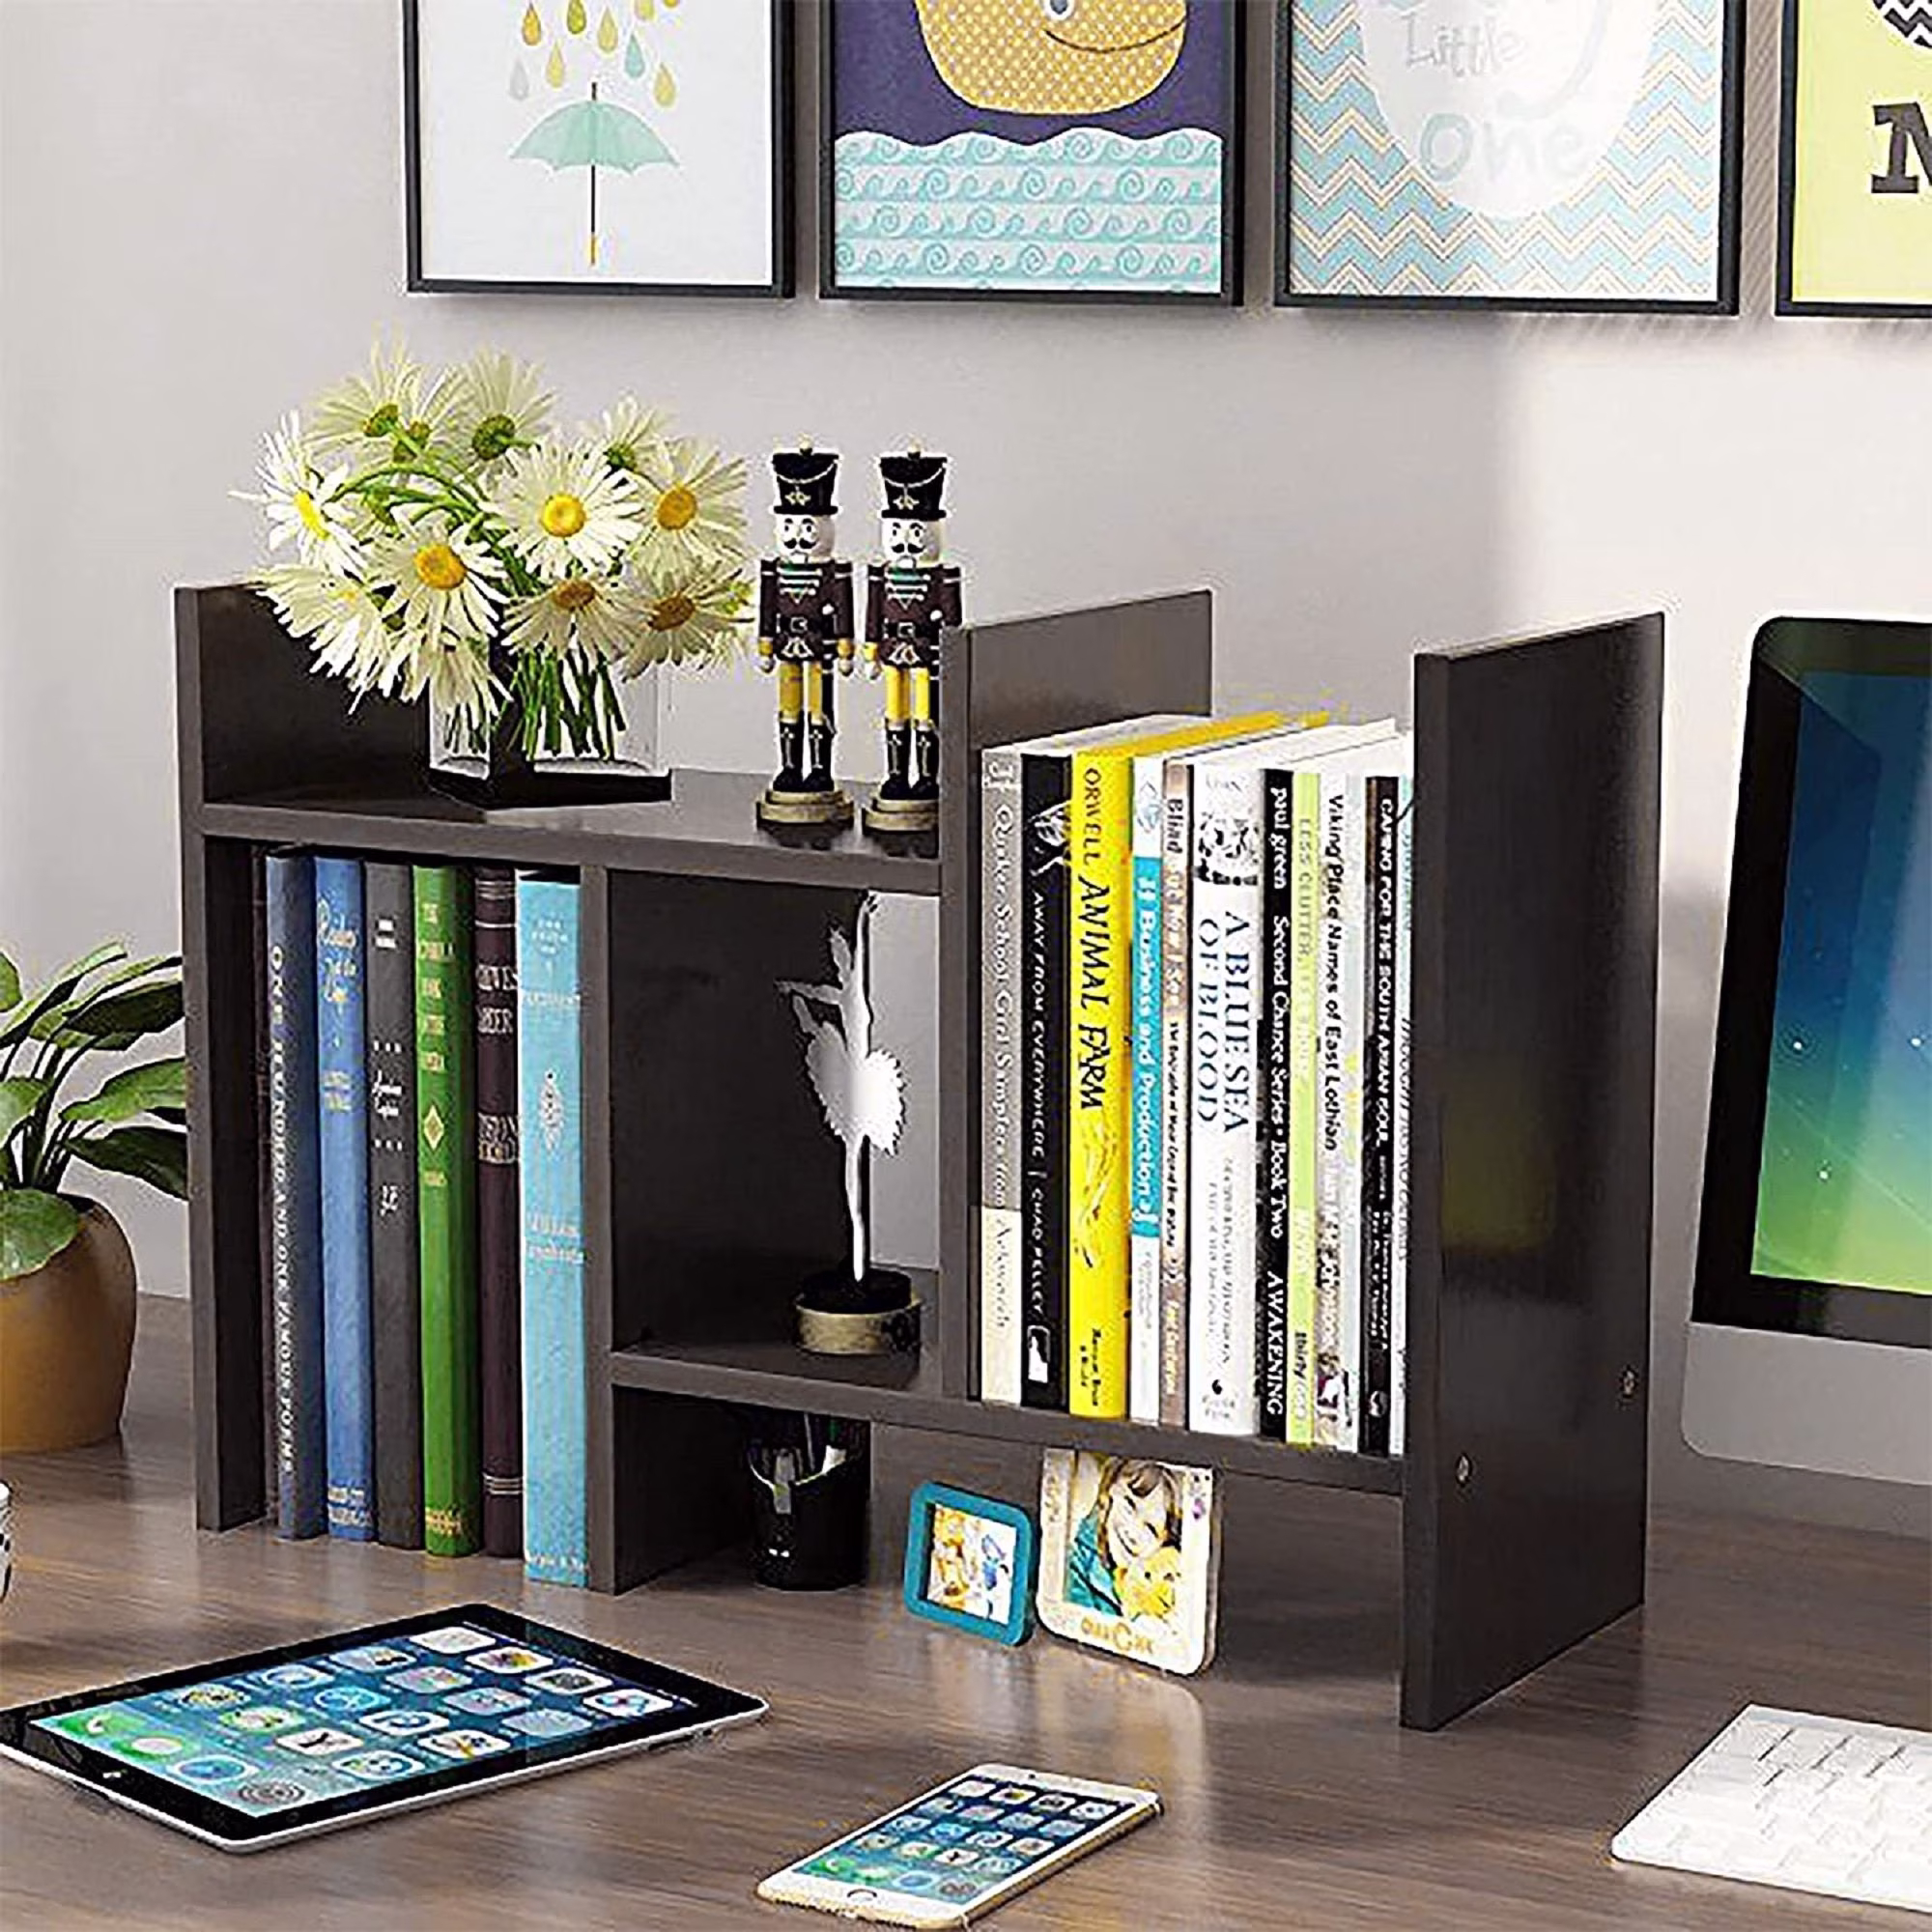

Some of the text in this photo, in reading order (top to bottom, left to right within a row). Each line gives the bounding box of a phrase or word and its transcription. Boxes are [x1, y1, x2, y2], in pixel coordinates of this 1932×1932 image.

[1167, 799, 1184, 854] Blind
[1379, 799, 1393, 871] CARING
[1033, 892, 1044, 947] AWAY
[1379, 876, 1392, 916] FOR
[994, 904, 1013, 980] School
[1078, 768, 1110, 1109] ORWELL ANIMAL FARM
[1139, 910, 1155, 1016] Business
[1324, 795, 1344, 1151] Viking Place Names of East Lothian
[1379, 923, 1391, 958] THE
[1198, 919, 1219, 1122] OF BLOOD
[1225, 912, 1249, 1133] A BLUE SEA
[1378, 966, 1391, 1031] SOUTH
[1139, 1024, 1155, 1065] and
[1378, 1035, 1390, 1093] ASIAN
[1137, 1073, 1155, 1195] Production
[1267, 787, 1290, 1415] paul green Second Chance Series Book Two AWAKENING
[274, 1191, 287, 1237] AND
[276, 1244, 288, 1291] ONE
[278, 1301, 291, 1388] FAMOUS
[280, 1396, 294, 1471] POEMS
